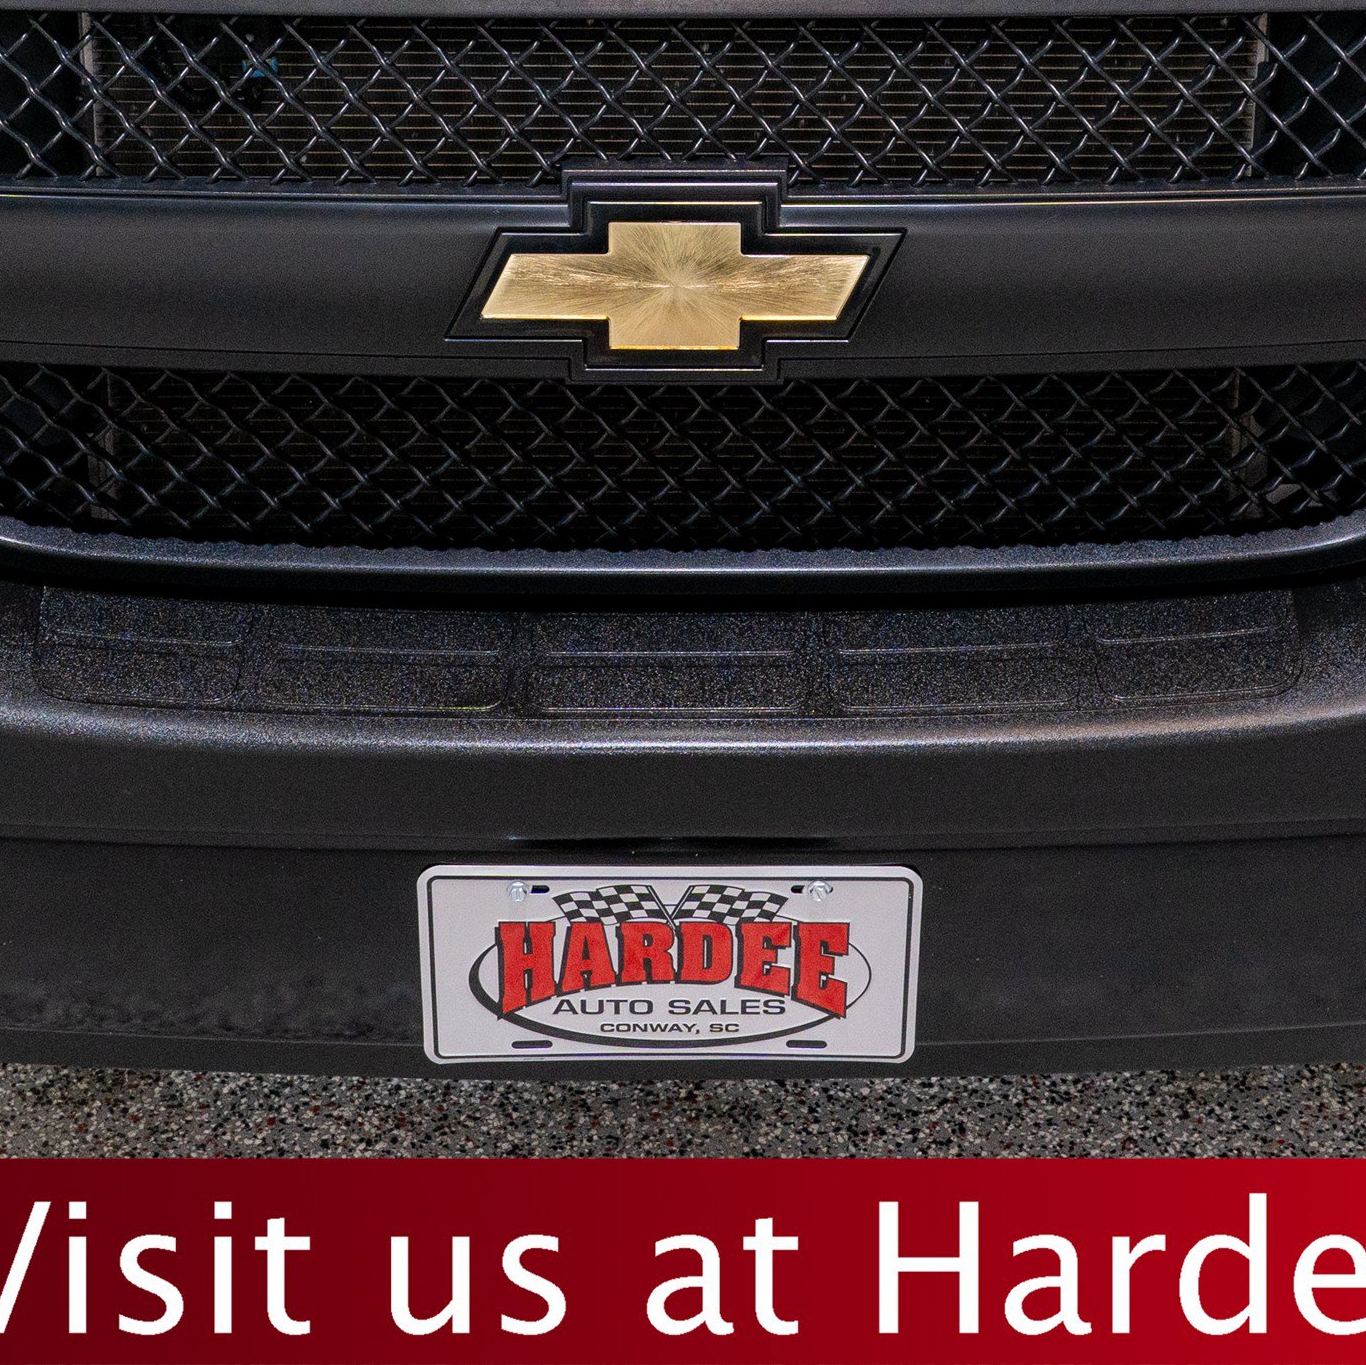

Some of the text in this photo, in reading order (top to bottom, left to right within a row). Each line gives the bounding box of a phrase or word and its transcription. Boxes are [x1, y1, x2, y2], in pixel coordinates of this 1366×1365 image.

[495, 921, 850, 1020] HARDEE
[553, 998, 786, 1016] AUTO SALES
[600, 1022, 740, 1035] CONWAY, SC
